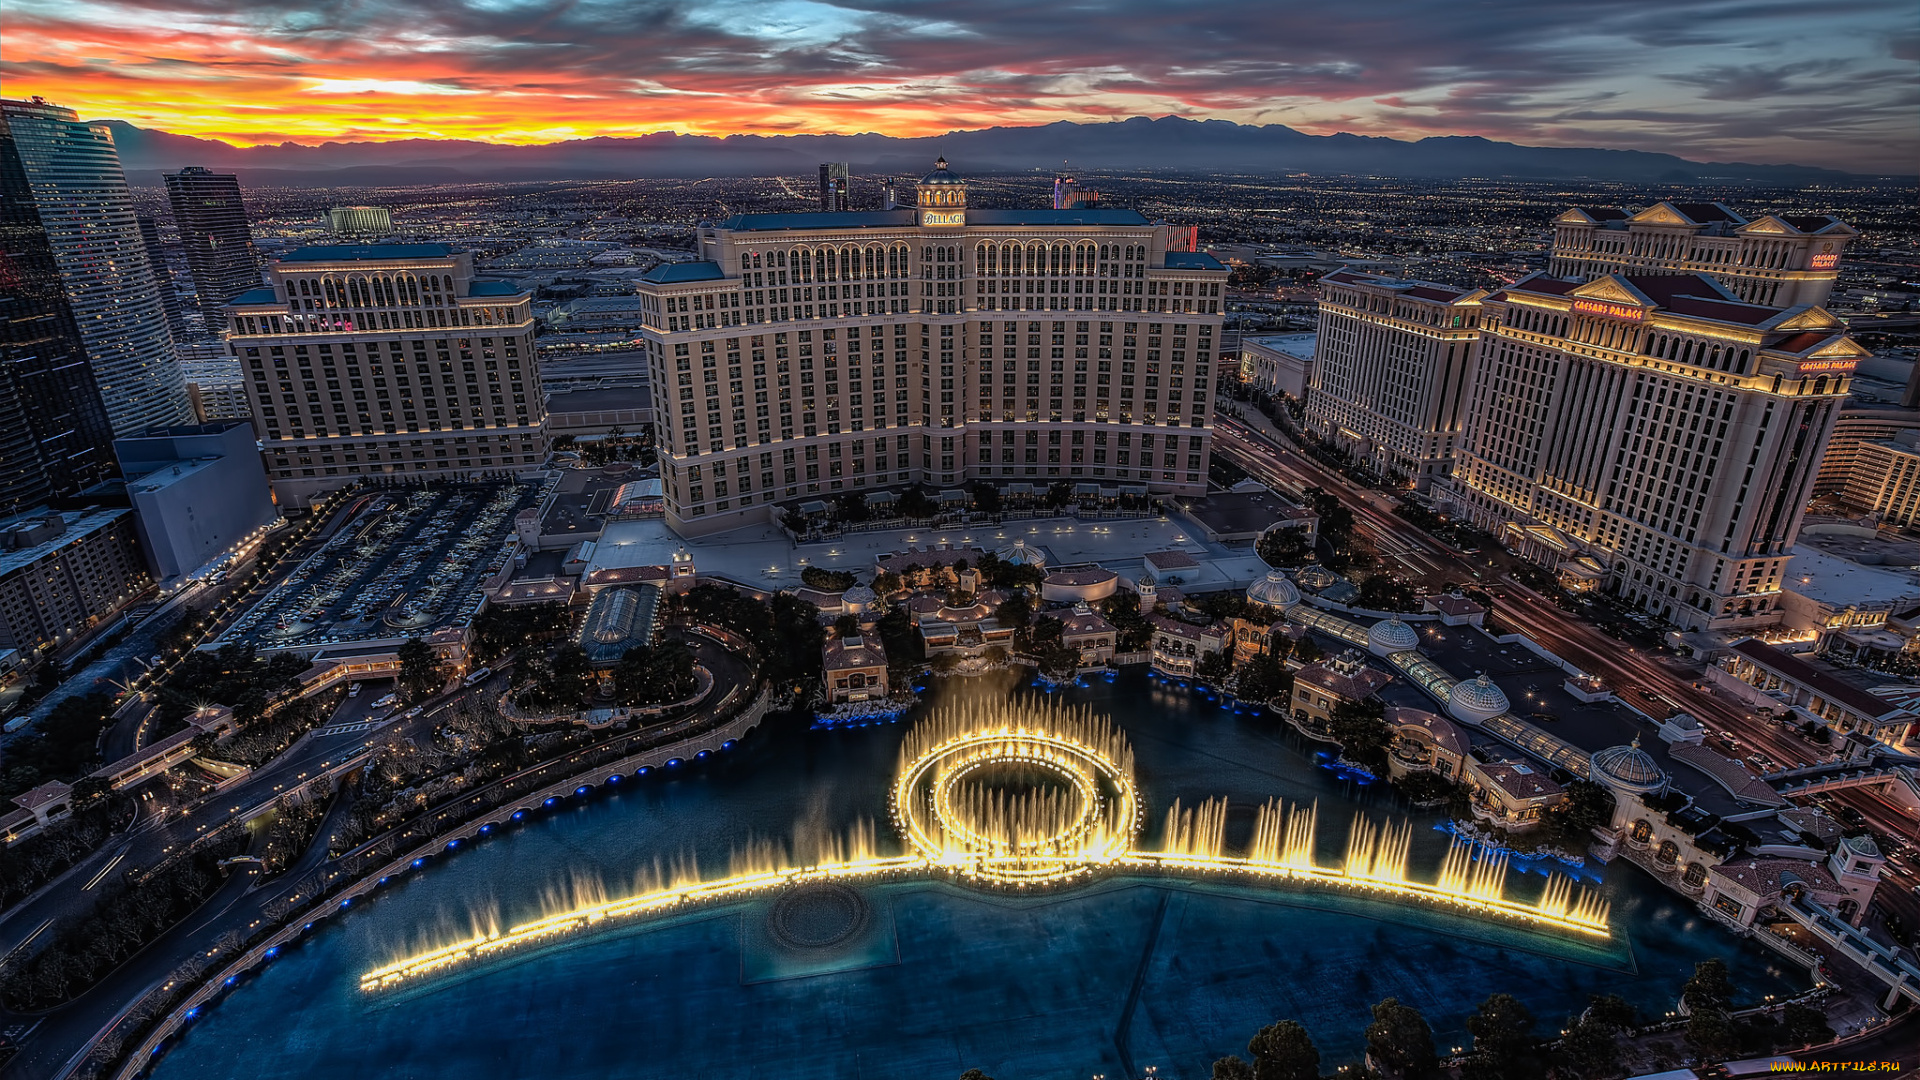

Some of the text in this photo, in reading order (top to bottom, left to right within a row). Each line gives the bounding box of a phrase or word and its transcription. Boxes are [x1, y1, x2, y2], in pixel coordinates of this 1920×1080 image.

[1574, 300, 1643, 320] CAESARS PALACE
[1800, 361, 1857, 371] CAESARS PALACE
